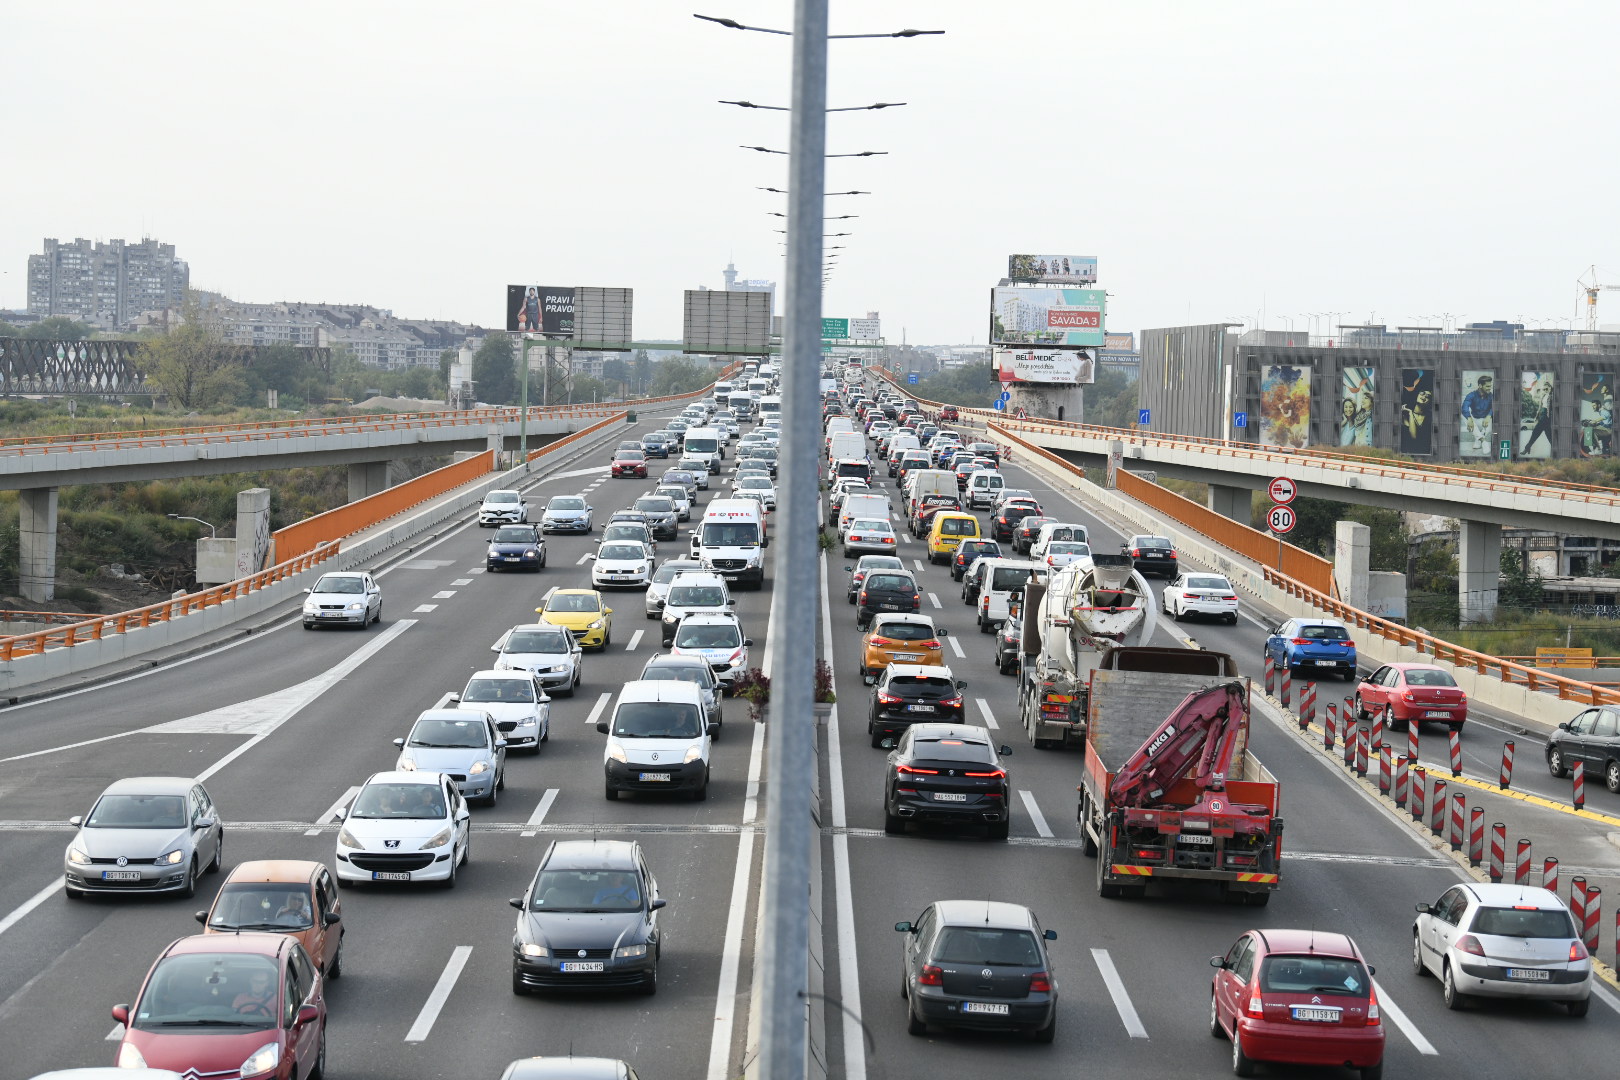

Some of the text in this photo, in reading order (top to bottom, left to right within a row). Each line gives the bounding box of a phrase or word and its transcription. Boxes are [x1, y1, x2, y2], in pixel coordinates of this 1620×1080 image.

[545, 295, 570, 304] PRAVI
[1050, 316, 1098, 326] SAVADA 3
[926, 497, 955, 506] Energizer
[1272, 512, 1290, 527] 80
[1147, 732, 1169, 757] MKG
[377, 872, 384, 880] BG
[565, 963, 603, 971] BG 1434-HS
[1511, 968, 1520, 977] BG
[968, 1002, 978, 1011] BG
[1297, 1009, 1338, 1020] BG 1158-XT
